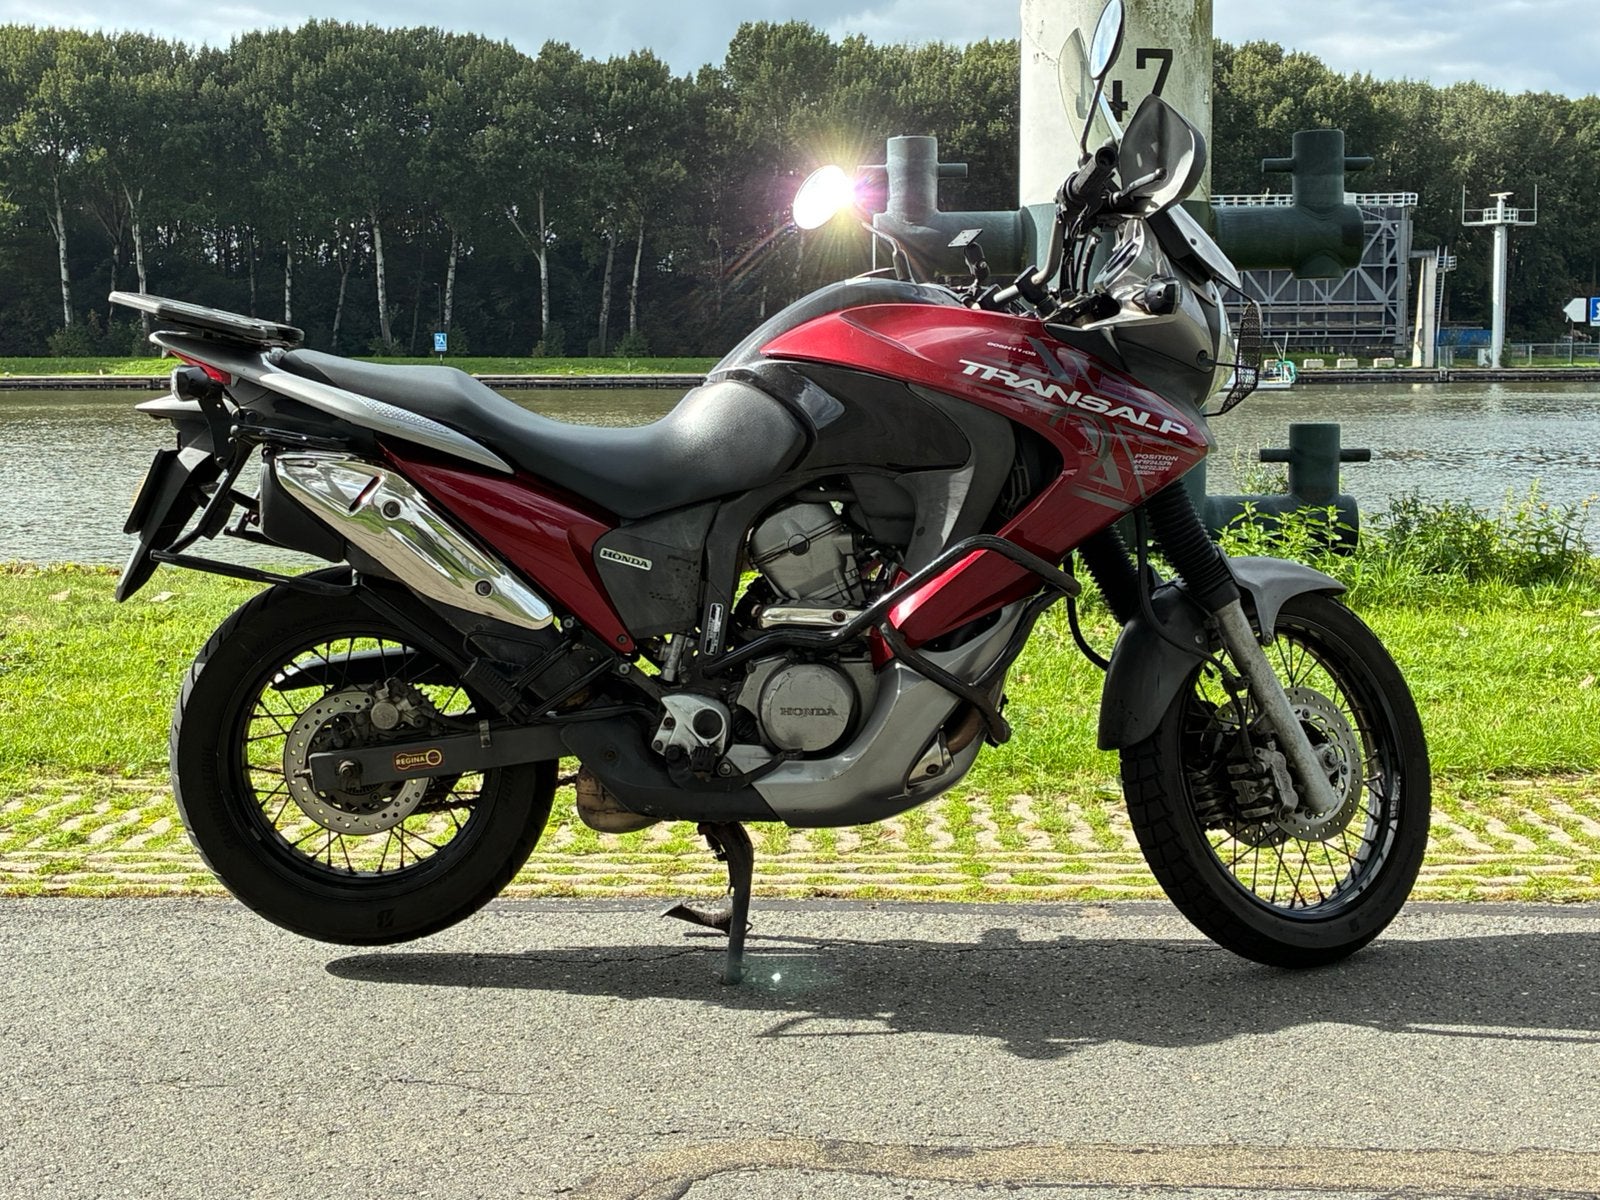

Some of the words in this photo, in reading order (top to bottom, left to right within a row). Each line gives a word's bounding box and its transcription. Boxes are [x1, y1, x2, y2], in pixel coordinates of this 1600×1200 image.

[958, 358, 1189, 436] TRANSALP
[1134, 453, 1179, 461] POSITION
[602, 550, 648, 568] HONDA
[780, 707, 838, 716] HONDA
[395, 756, 425, 766] REGINA
